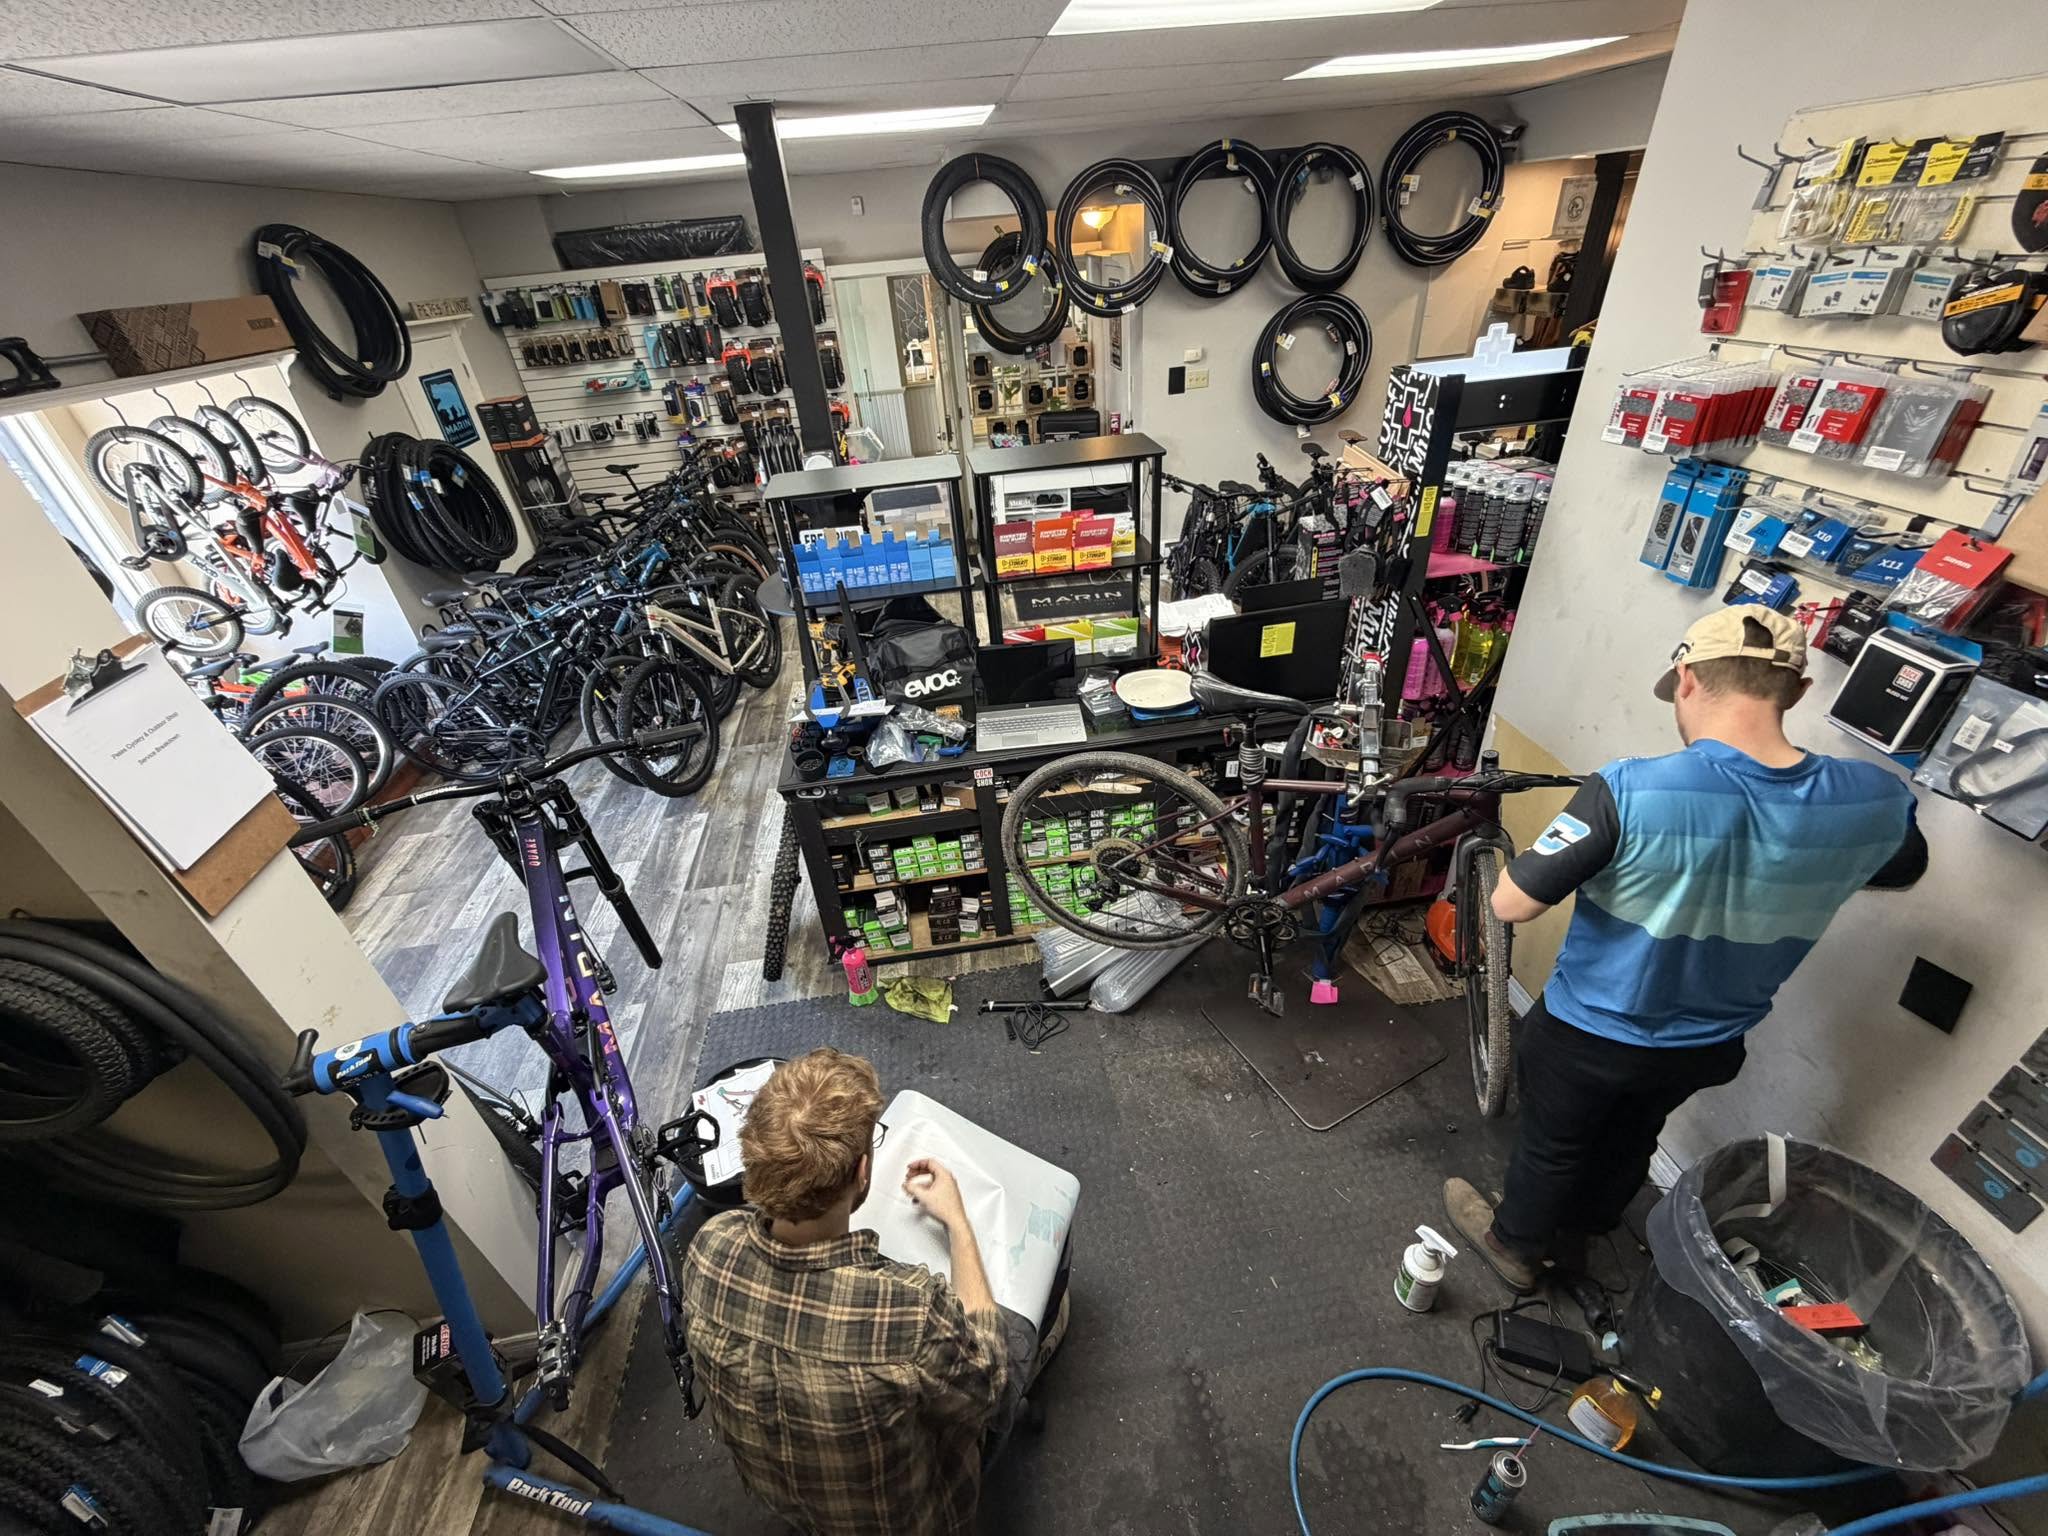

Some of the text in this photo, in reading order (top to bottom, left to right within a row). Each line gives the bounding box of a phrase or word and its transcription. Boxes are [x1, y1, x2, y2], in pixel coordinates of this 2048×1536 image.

[444, 419, 472, 435] MARIN
[1814, 530, 1832, 542] X10
[1877, 558, 1904, 570] X11
[1031, 590, 1122, 605] MARIN
[525, 838, 542, 868] QUAKE
